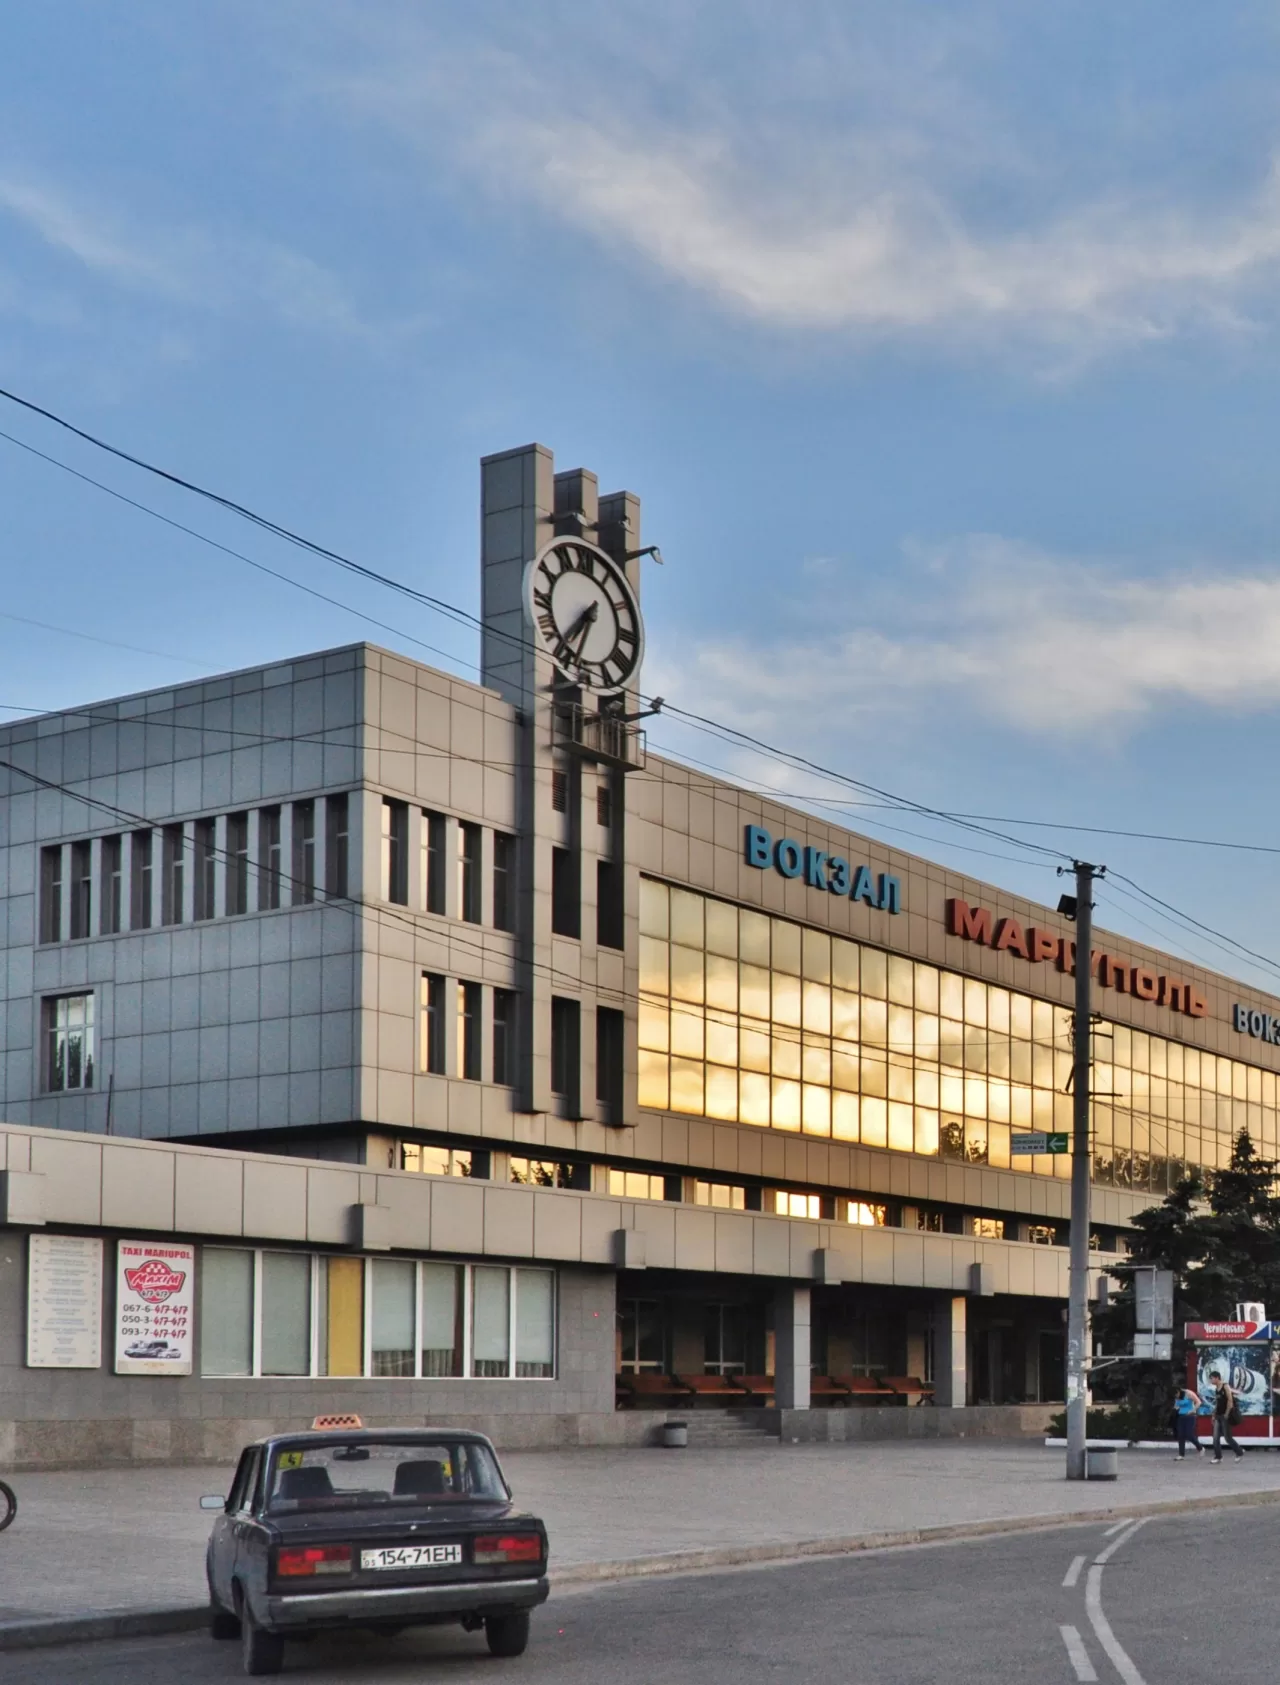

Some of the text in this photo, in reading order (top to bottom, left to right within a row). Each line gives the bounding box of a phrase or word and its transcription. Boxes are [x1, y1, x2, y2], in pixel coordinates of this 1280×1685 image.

[745, 824, 901, 915] ВОКЗАЛ
[122, 1247, 192, 1259] TAXI MARIUPOL
